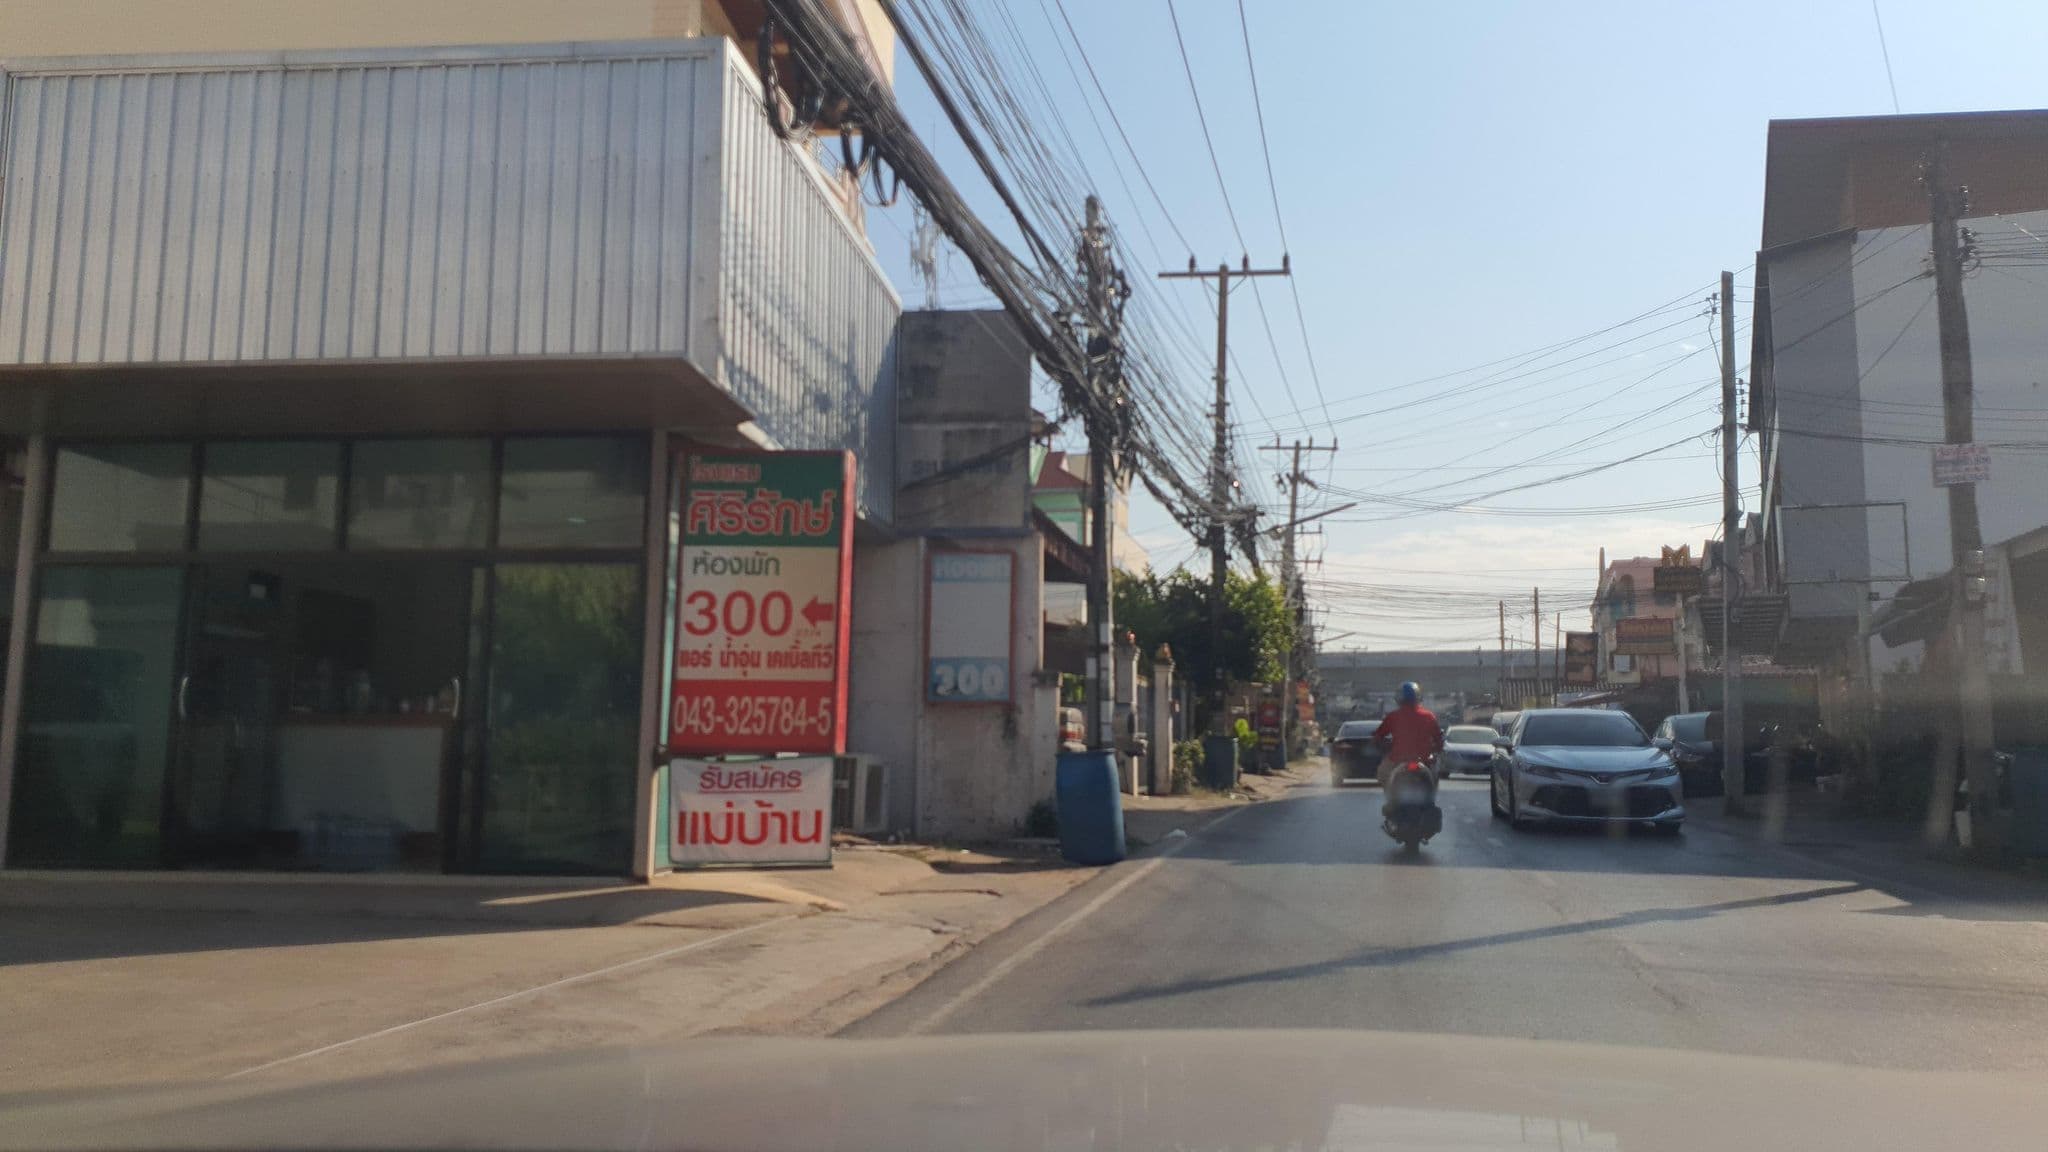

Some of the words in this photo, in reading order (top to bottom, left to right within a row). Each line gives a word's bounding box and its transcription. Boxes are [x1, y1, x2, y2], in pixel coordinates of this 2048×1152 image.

[687, 488, 837, 536] ศิริรักษ์
[692, 551, 781, 577] ห้องพัก
[684, 590, 794, 637] 300
[679, 642, 713, 668] แอร์
[674, 695, 832, 735] 043-325784-5
[700, 764, 802, 790] รับสมัคร
[677, 800, 823, 845] แม่บ้าน
